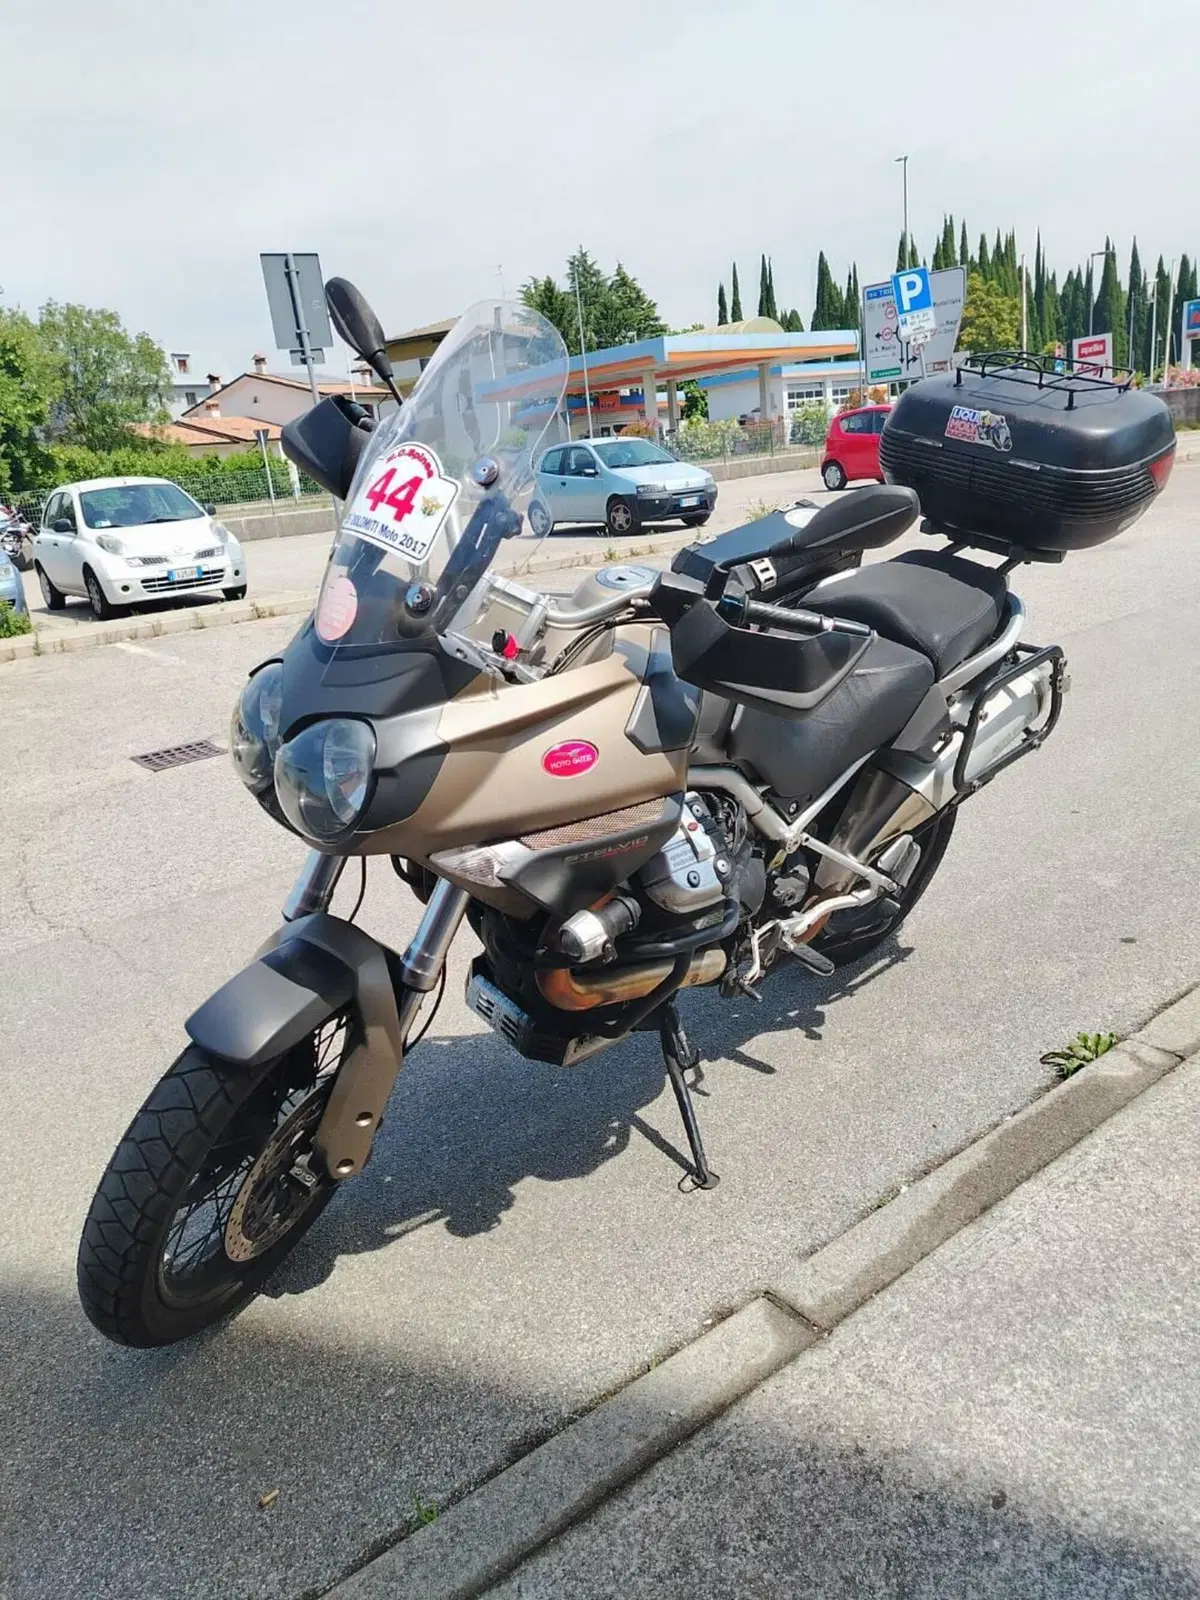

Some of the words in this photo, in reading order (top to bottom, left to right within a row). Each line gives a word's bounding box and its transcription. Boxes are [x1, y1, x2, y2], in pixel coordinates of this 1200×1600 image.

[898, 273, 923, 311] P
[1080, 342, 1104, 356] aprilia
[949, 418, 977, 434] MOLY
[365, 467, 423, 523] 44
[379, 523, 399, 542] Moto
[399, 533, 427, 555] 2017
[550, 759, 571, 770] MOTO
[564, 835, 649, 863] STELVIO
